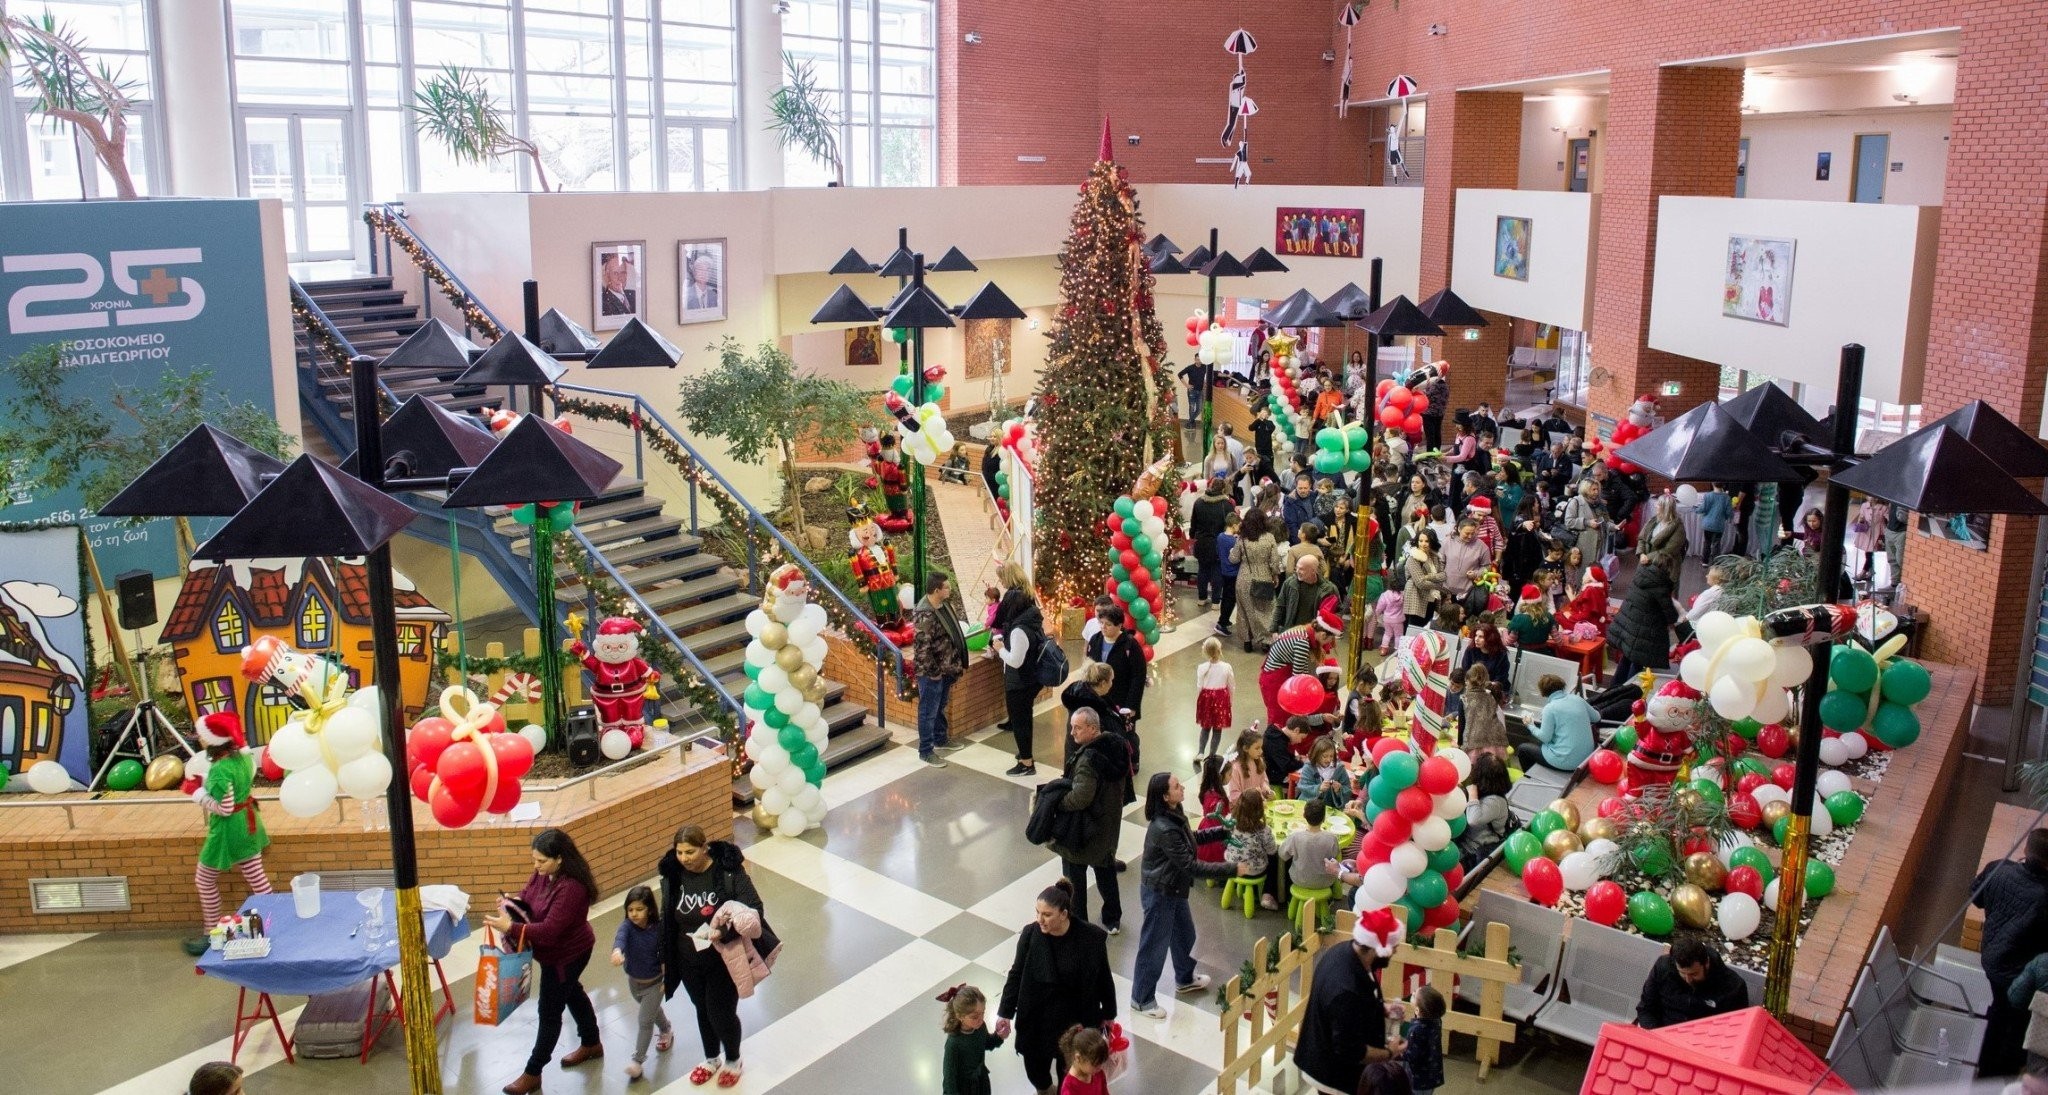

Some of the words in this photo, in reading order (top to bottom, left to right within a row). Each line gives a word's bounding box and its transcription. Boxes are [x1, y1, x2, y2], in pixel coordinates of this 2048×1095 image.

[3, 247, 206, 334] 25
[90, 300, 132, 310] ΧΡΟΝΙΑ
[123, 527, 148, 544] ζωή
